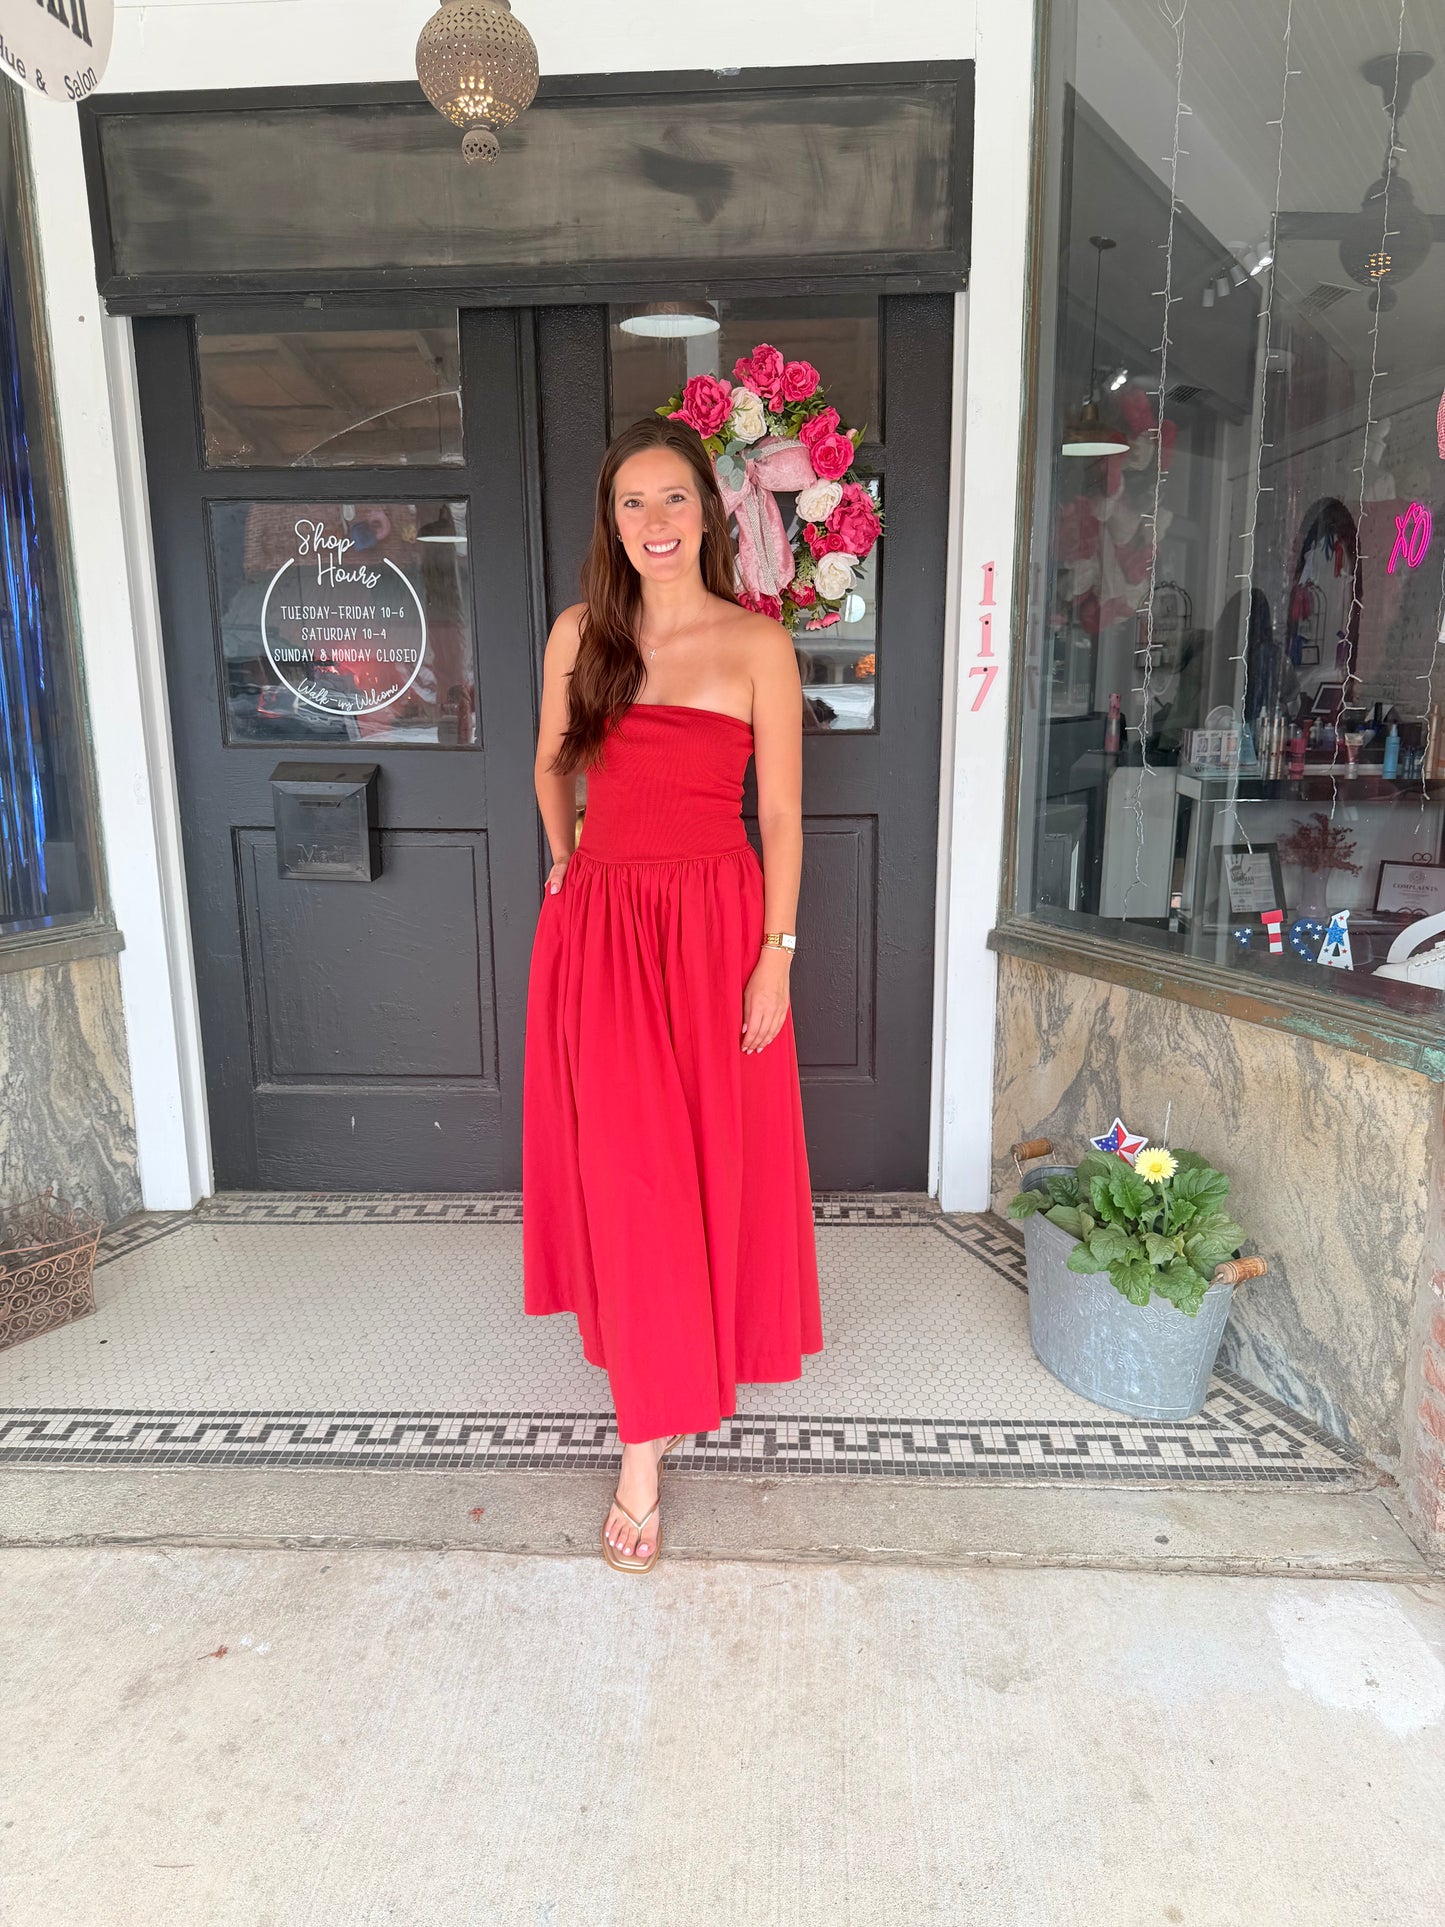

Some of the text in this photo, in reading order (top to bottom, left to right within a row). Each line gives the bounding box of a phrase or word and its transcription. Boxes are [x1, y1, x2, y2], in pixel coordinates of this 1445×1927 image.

[36, 68, 49, 95] &
[64, 66, 98, 100] Salon
[294, 519, 356, 566] Shop
[317, 552, 382, 589] Hours
[280, 605, 405, 620] TUESDAY-FRIDAY 10-6
[301, 626, 387, 641] SATURDAY 10-4
[273, 648, 418, 663] SUNDAY & MONDAY CLOSED
[355, 683, 399, 710] Welcome
